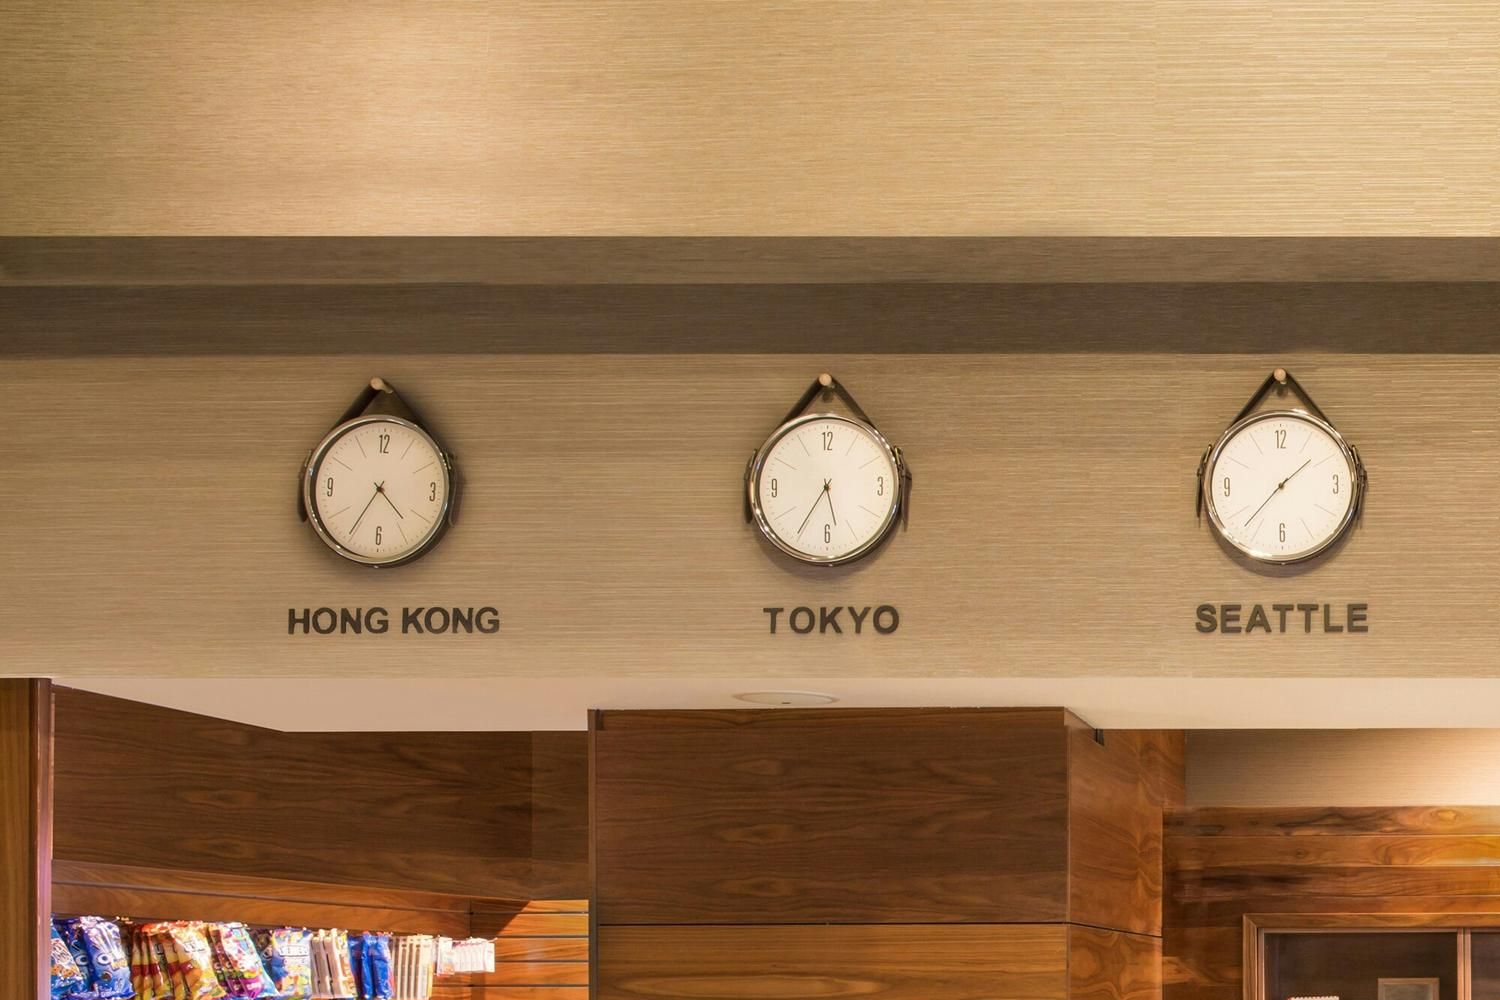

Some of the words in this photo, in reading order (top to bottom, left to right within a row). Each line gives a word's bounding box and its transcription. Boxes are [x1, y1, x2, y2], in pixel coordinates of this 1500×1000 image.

[379, 434, 390, 453] 12
[822, 432, 833, 450] 12
[1275, 430, 1286, 448] 12
[327, 477, 333, 497] 9
[429, 482, 436, 501] 3
[772, 479, 777, 497] 9
[877, 476, 883, 496] 3
[1224, 477, 1230, 497] 9
[1333, 475, 1339, 494] 3
[376, 526, 382, 545] 6
[824, 524, 830, 543] 6
[1279, 523, 1285, 542] 6
[287, 606, 389, 635] HONG
[401, 606, 501, 635] KONG
[763, 605, 901, 635] TOKYO
[1195, 603, 1369, 634] SEATTLE
